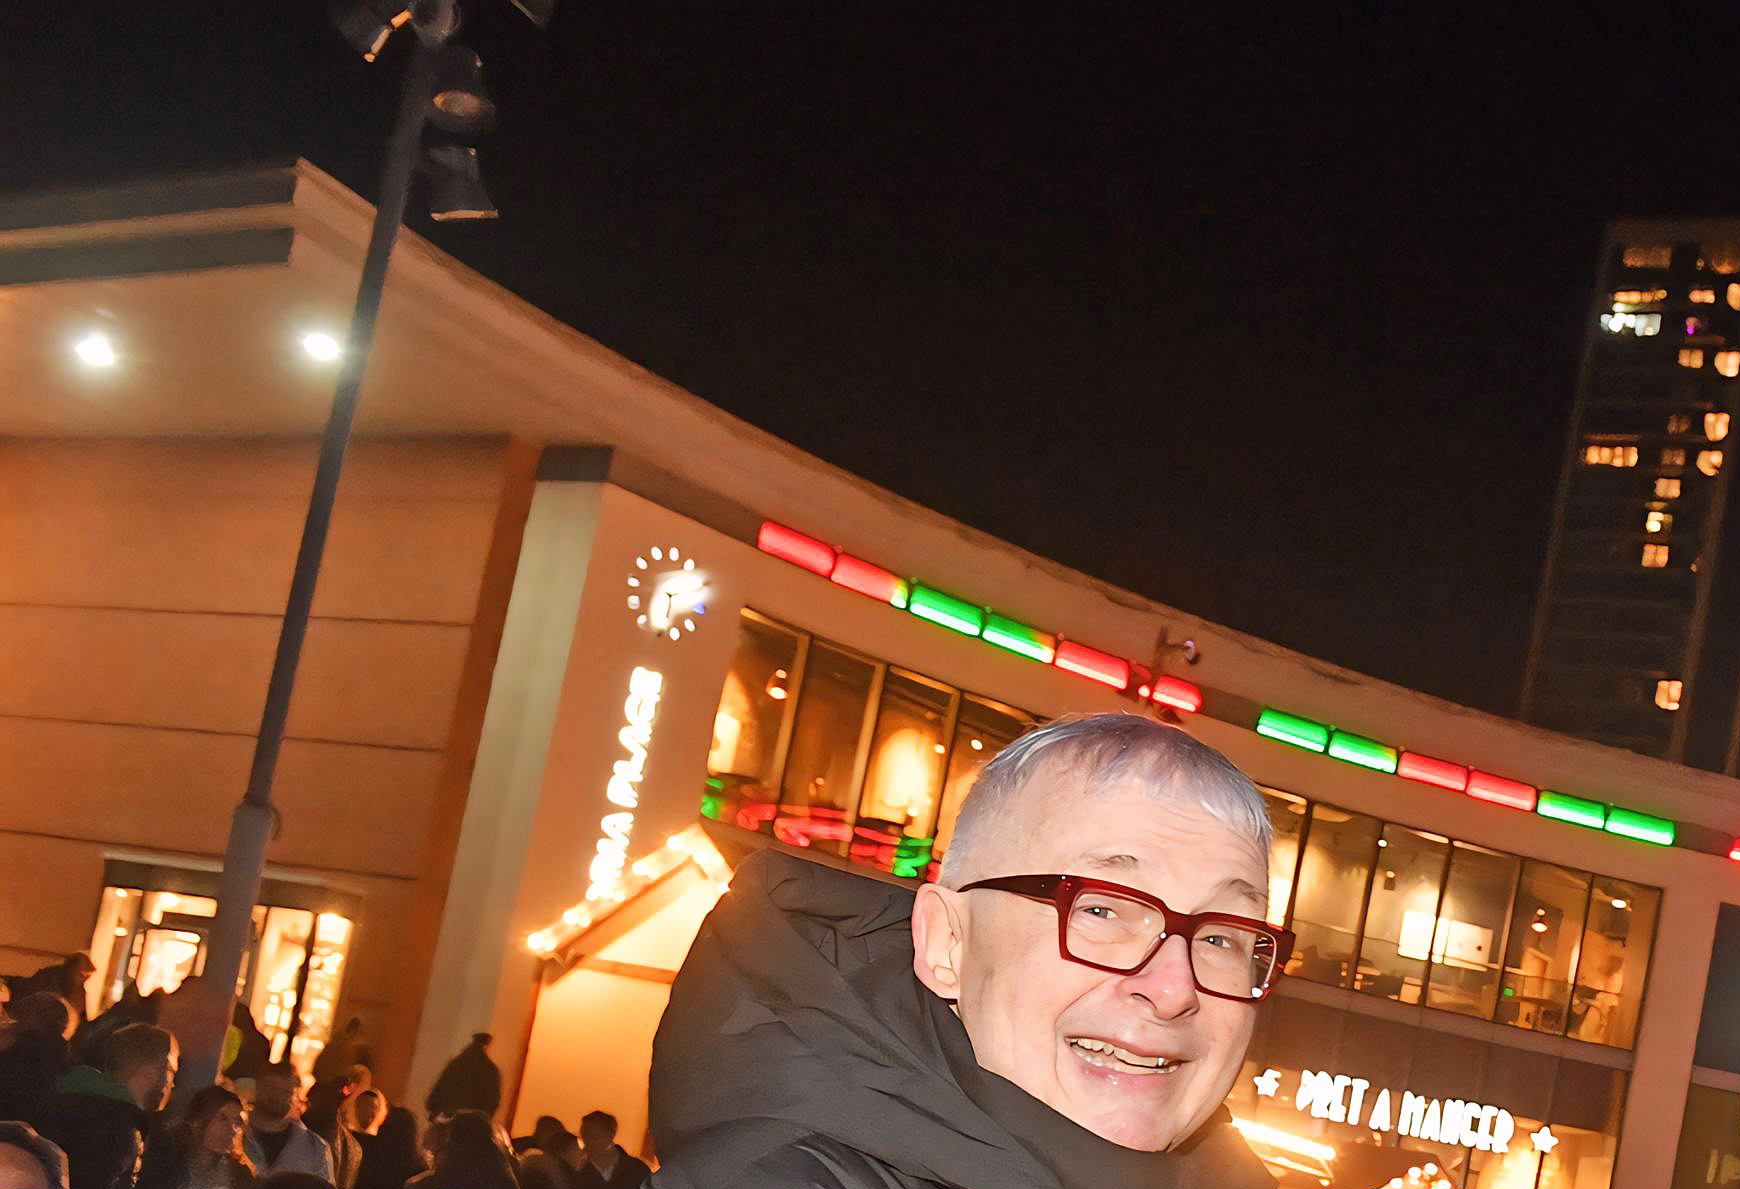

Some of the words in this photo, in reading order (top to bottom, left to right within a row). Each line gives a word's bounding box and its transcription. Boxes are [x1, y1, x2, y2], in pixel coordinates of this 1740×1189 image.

[1296, 1070, 1370, 1126] PRET
[1368, 1088, 1391, 1132] A
[1397, 1090, 1515, 1153] MANGER
